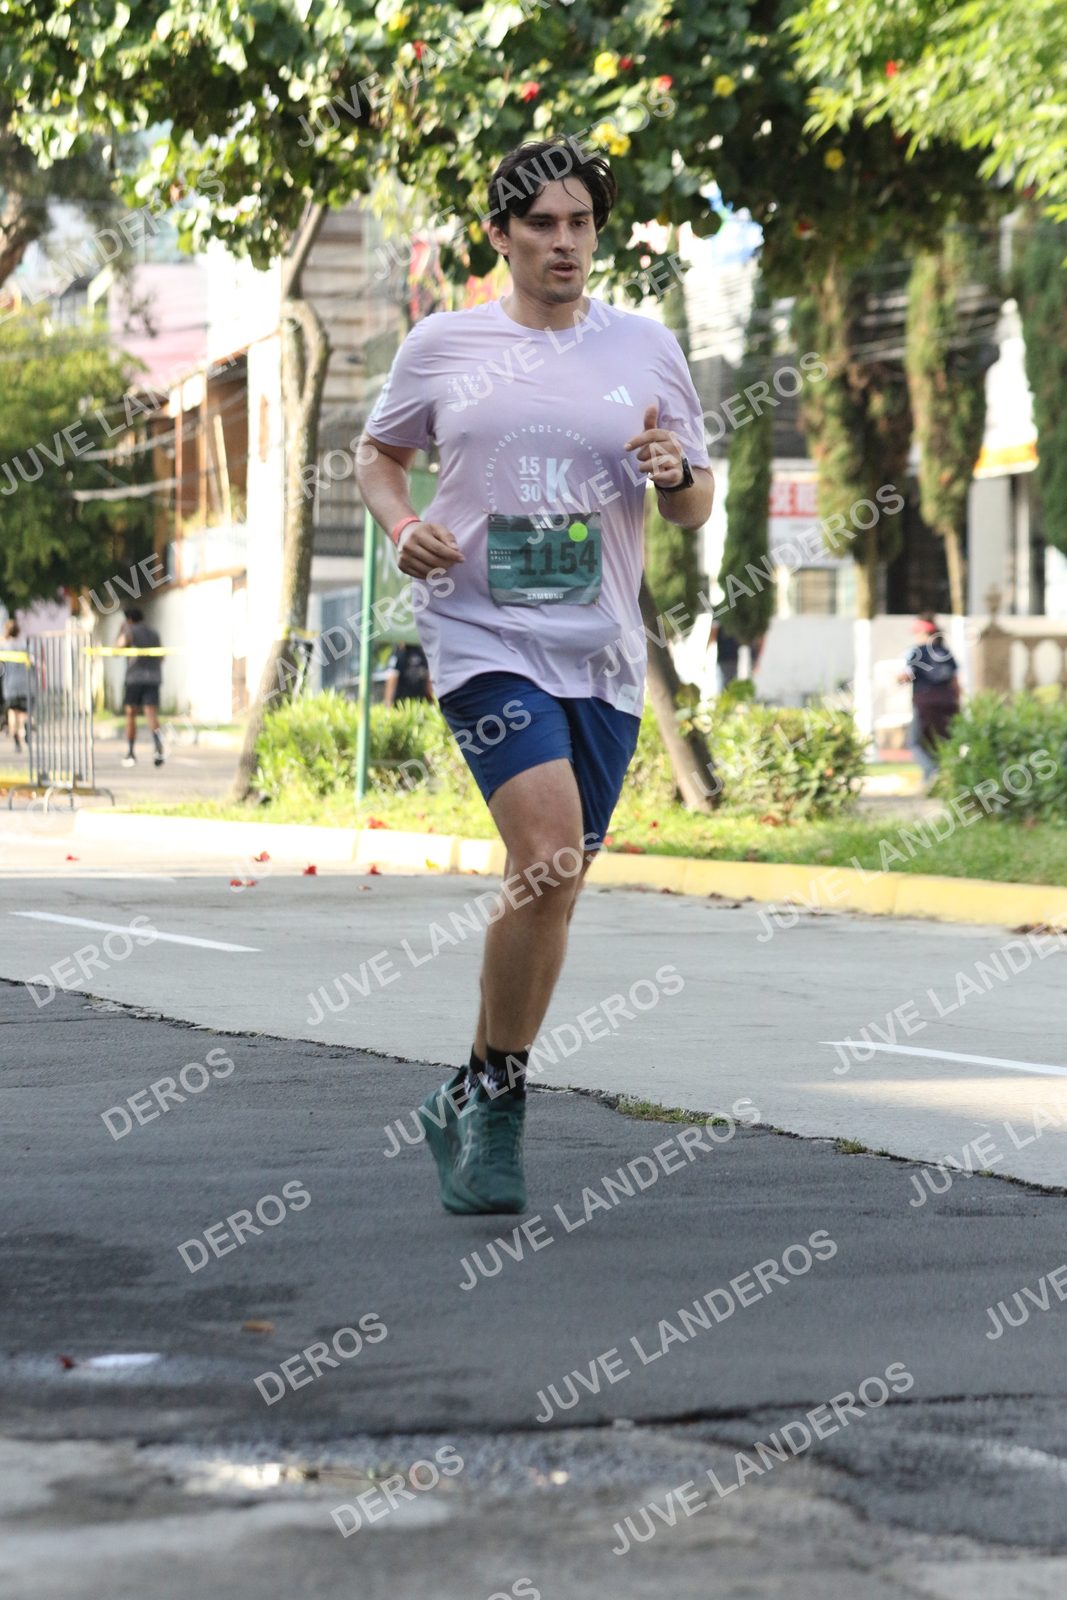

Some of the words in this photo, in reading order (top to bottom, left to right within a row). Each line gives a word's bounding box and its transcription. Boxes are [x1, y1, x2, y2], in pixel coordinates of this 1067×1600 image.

[519, 455, 540, 475] 15
[520, 484, 541, 503] 30
[546, 457, 573, 503] K
[519, 539, 598, 576] 1154
